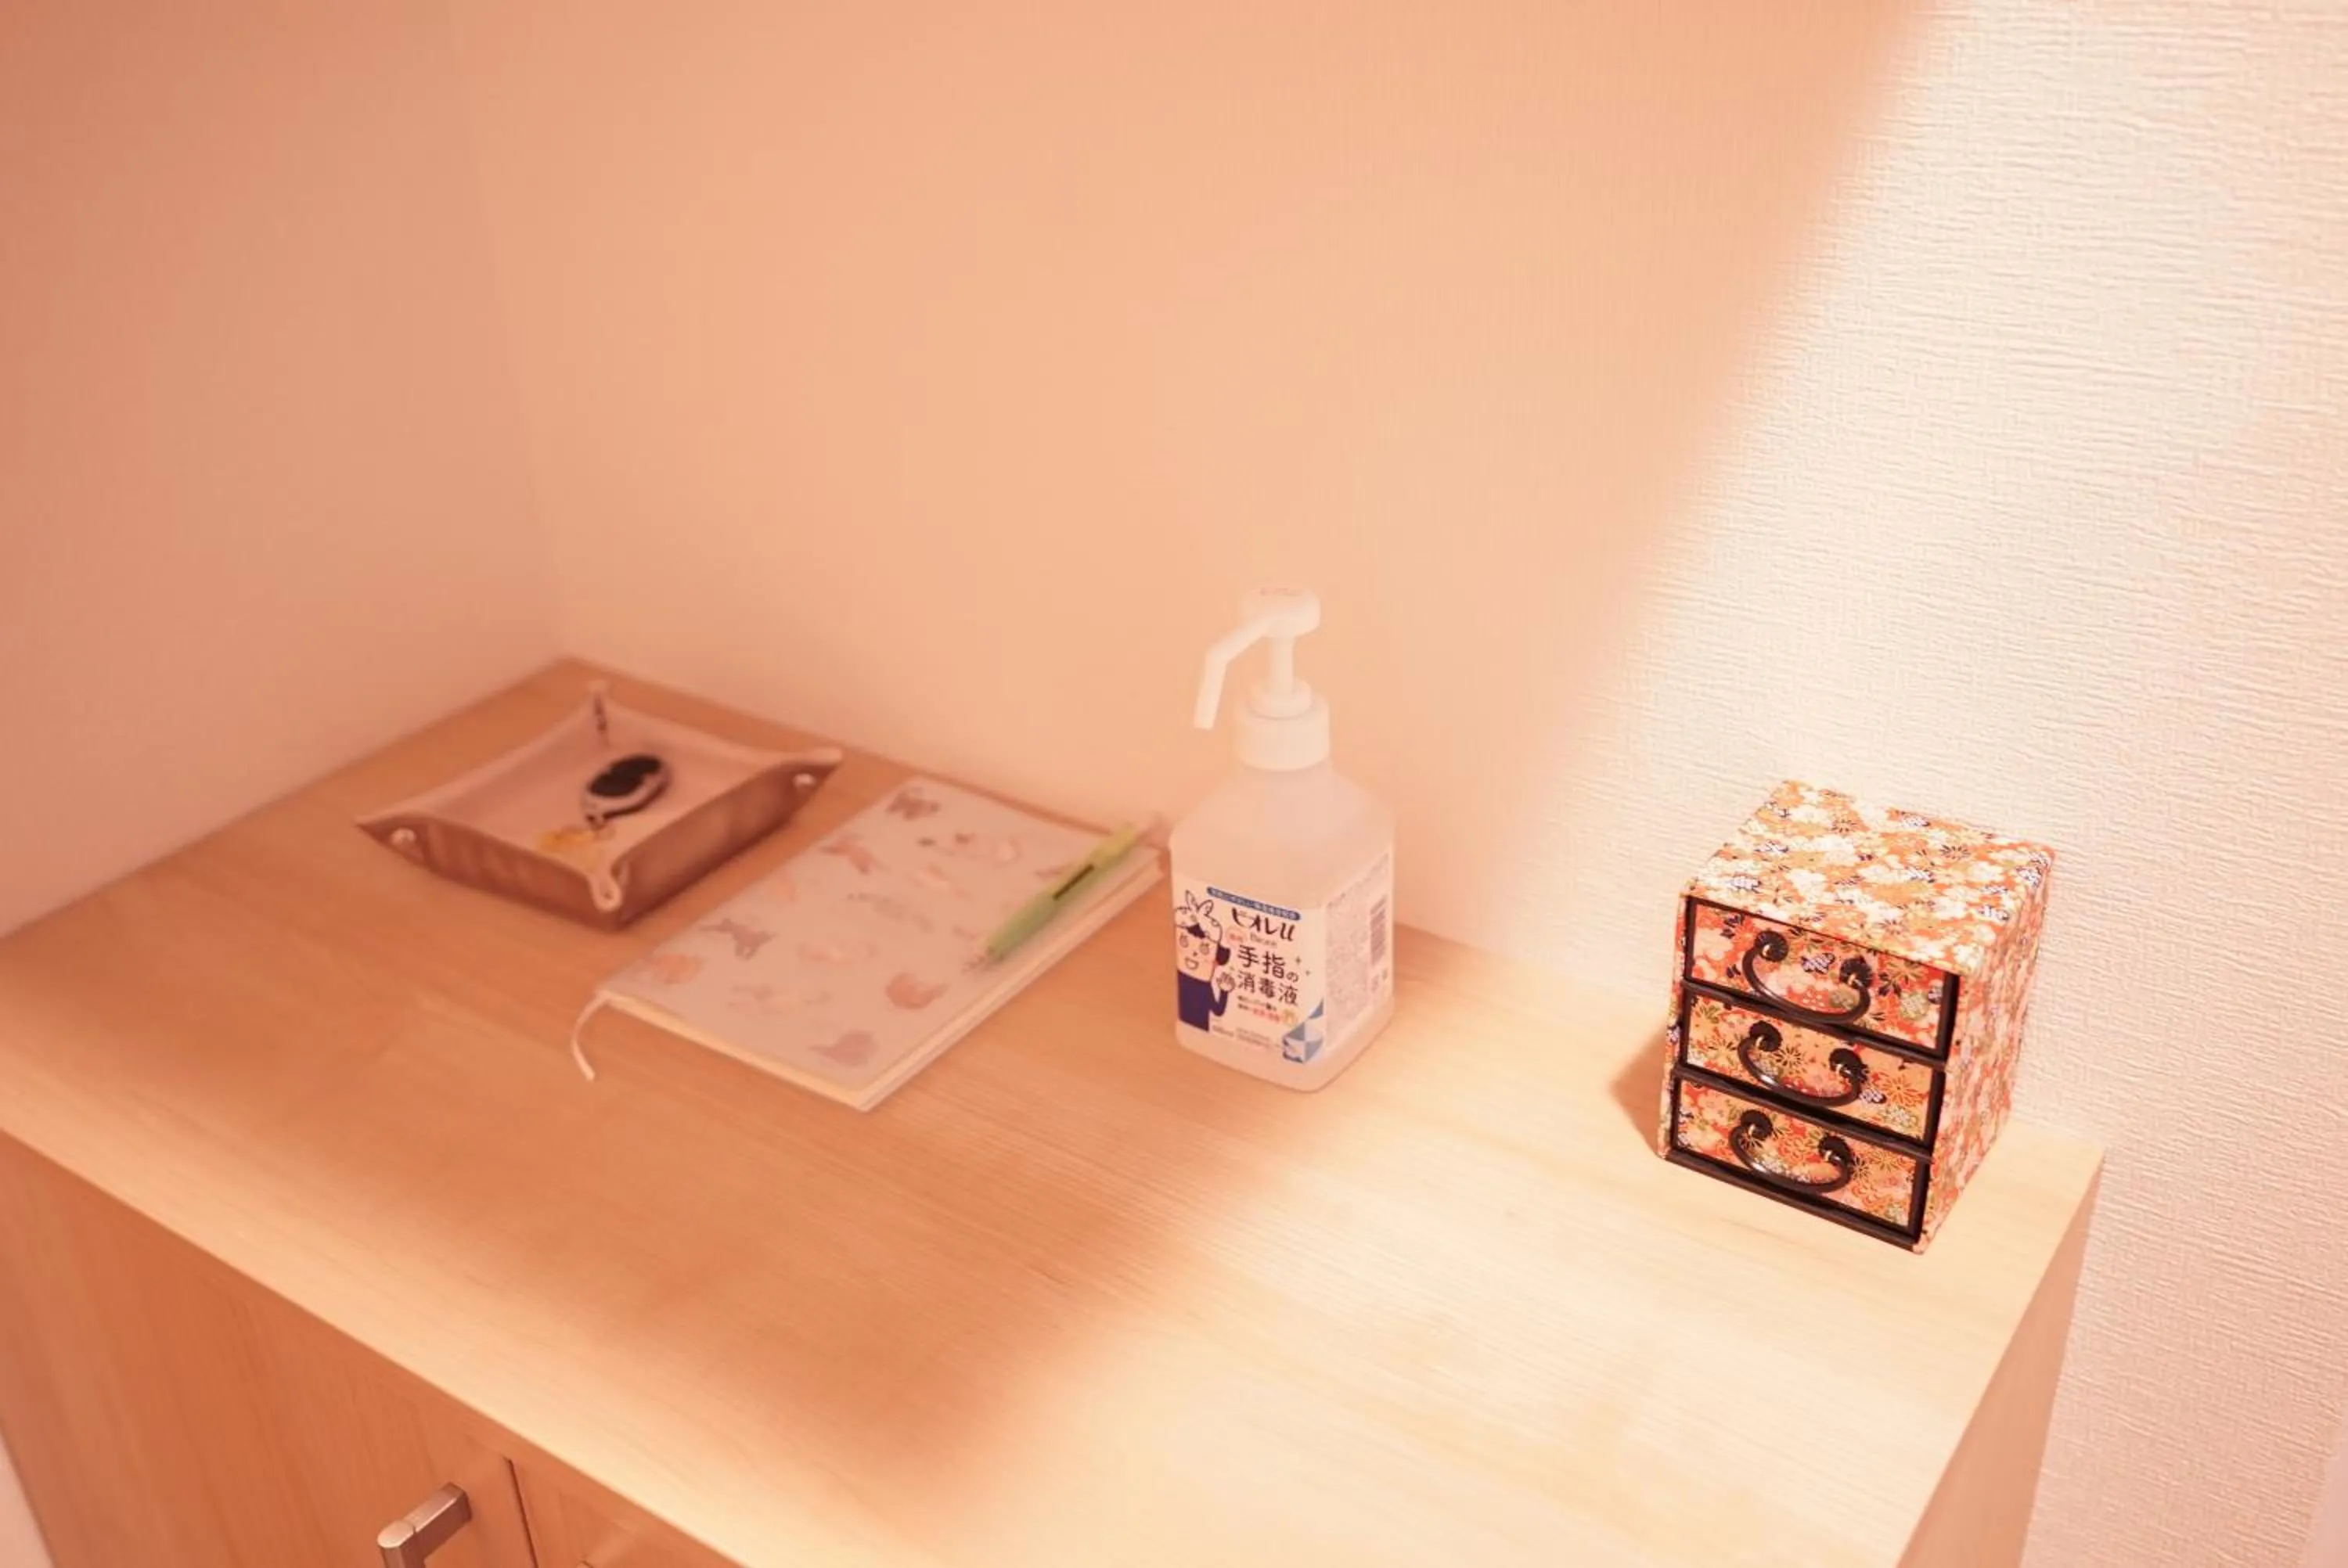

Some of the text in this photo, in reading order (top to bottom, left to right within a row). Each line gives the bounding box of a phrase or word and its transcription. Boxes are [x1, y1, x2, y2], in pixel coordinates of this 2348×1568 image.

[1237, 944, 1299, 983] 手指の
[1237, 970, 1299, 1006] 消毒液
